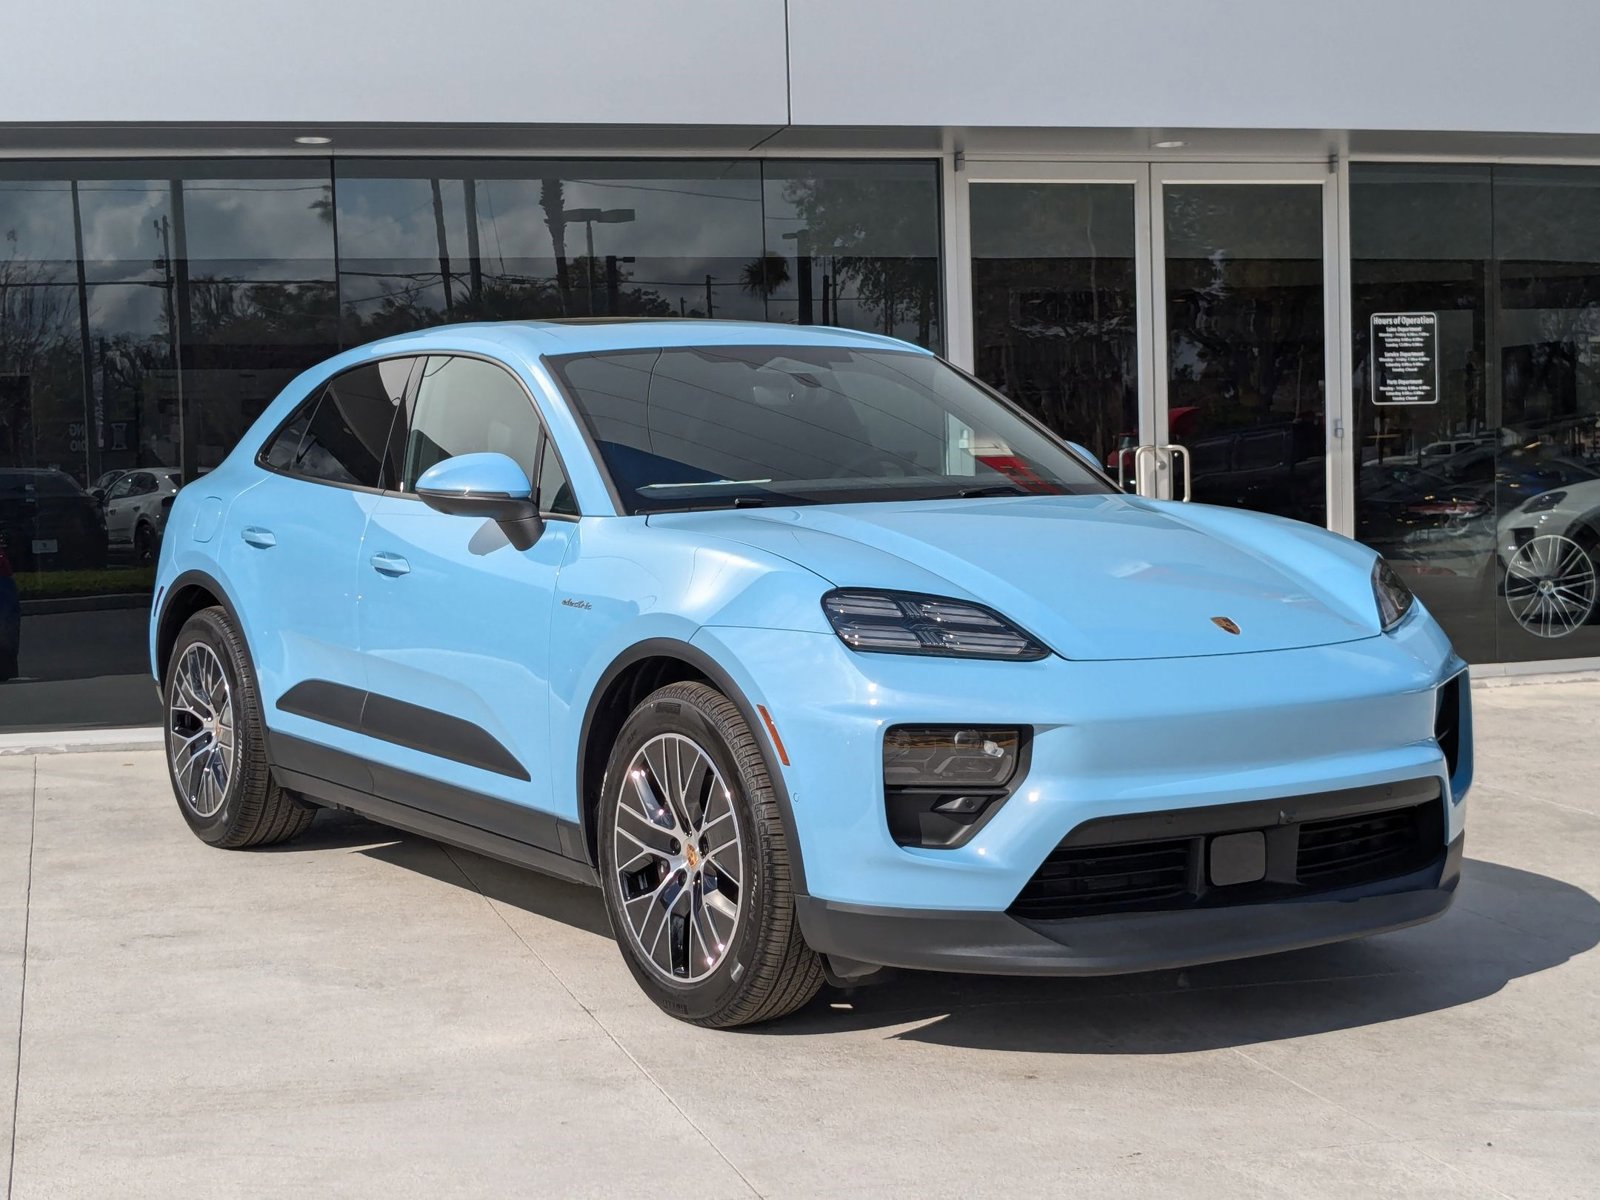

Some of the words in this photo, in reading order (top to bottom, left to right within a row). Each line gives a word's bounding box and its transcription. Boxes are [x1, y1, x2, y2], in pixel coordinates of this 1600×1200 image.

[1373, 316, 1392, 325] Hours
[1393, 316, 1400, 324] of
[1401, 316, 1434, 326] Operation
